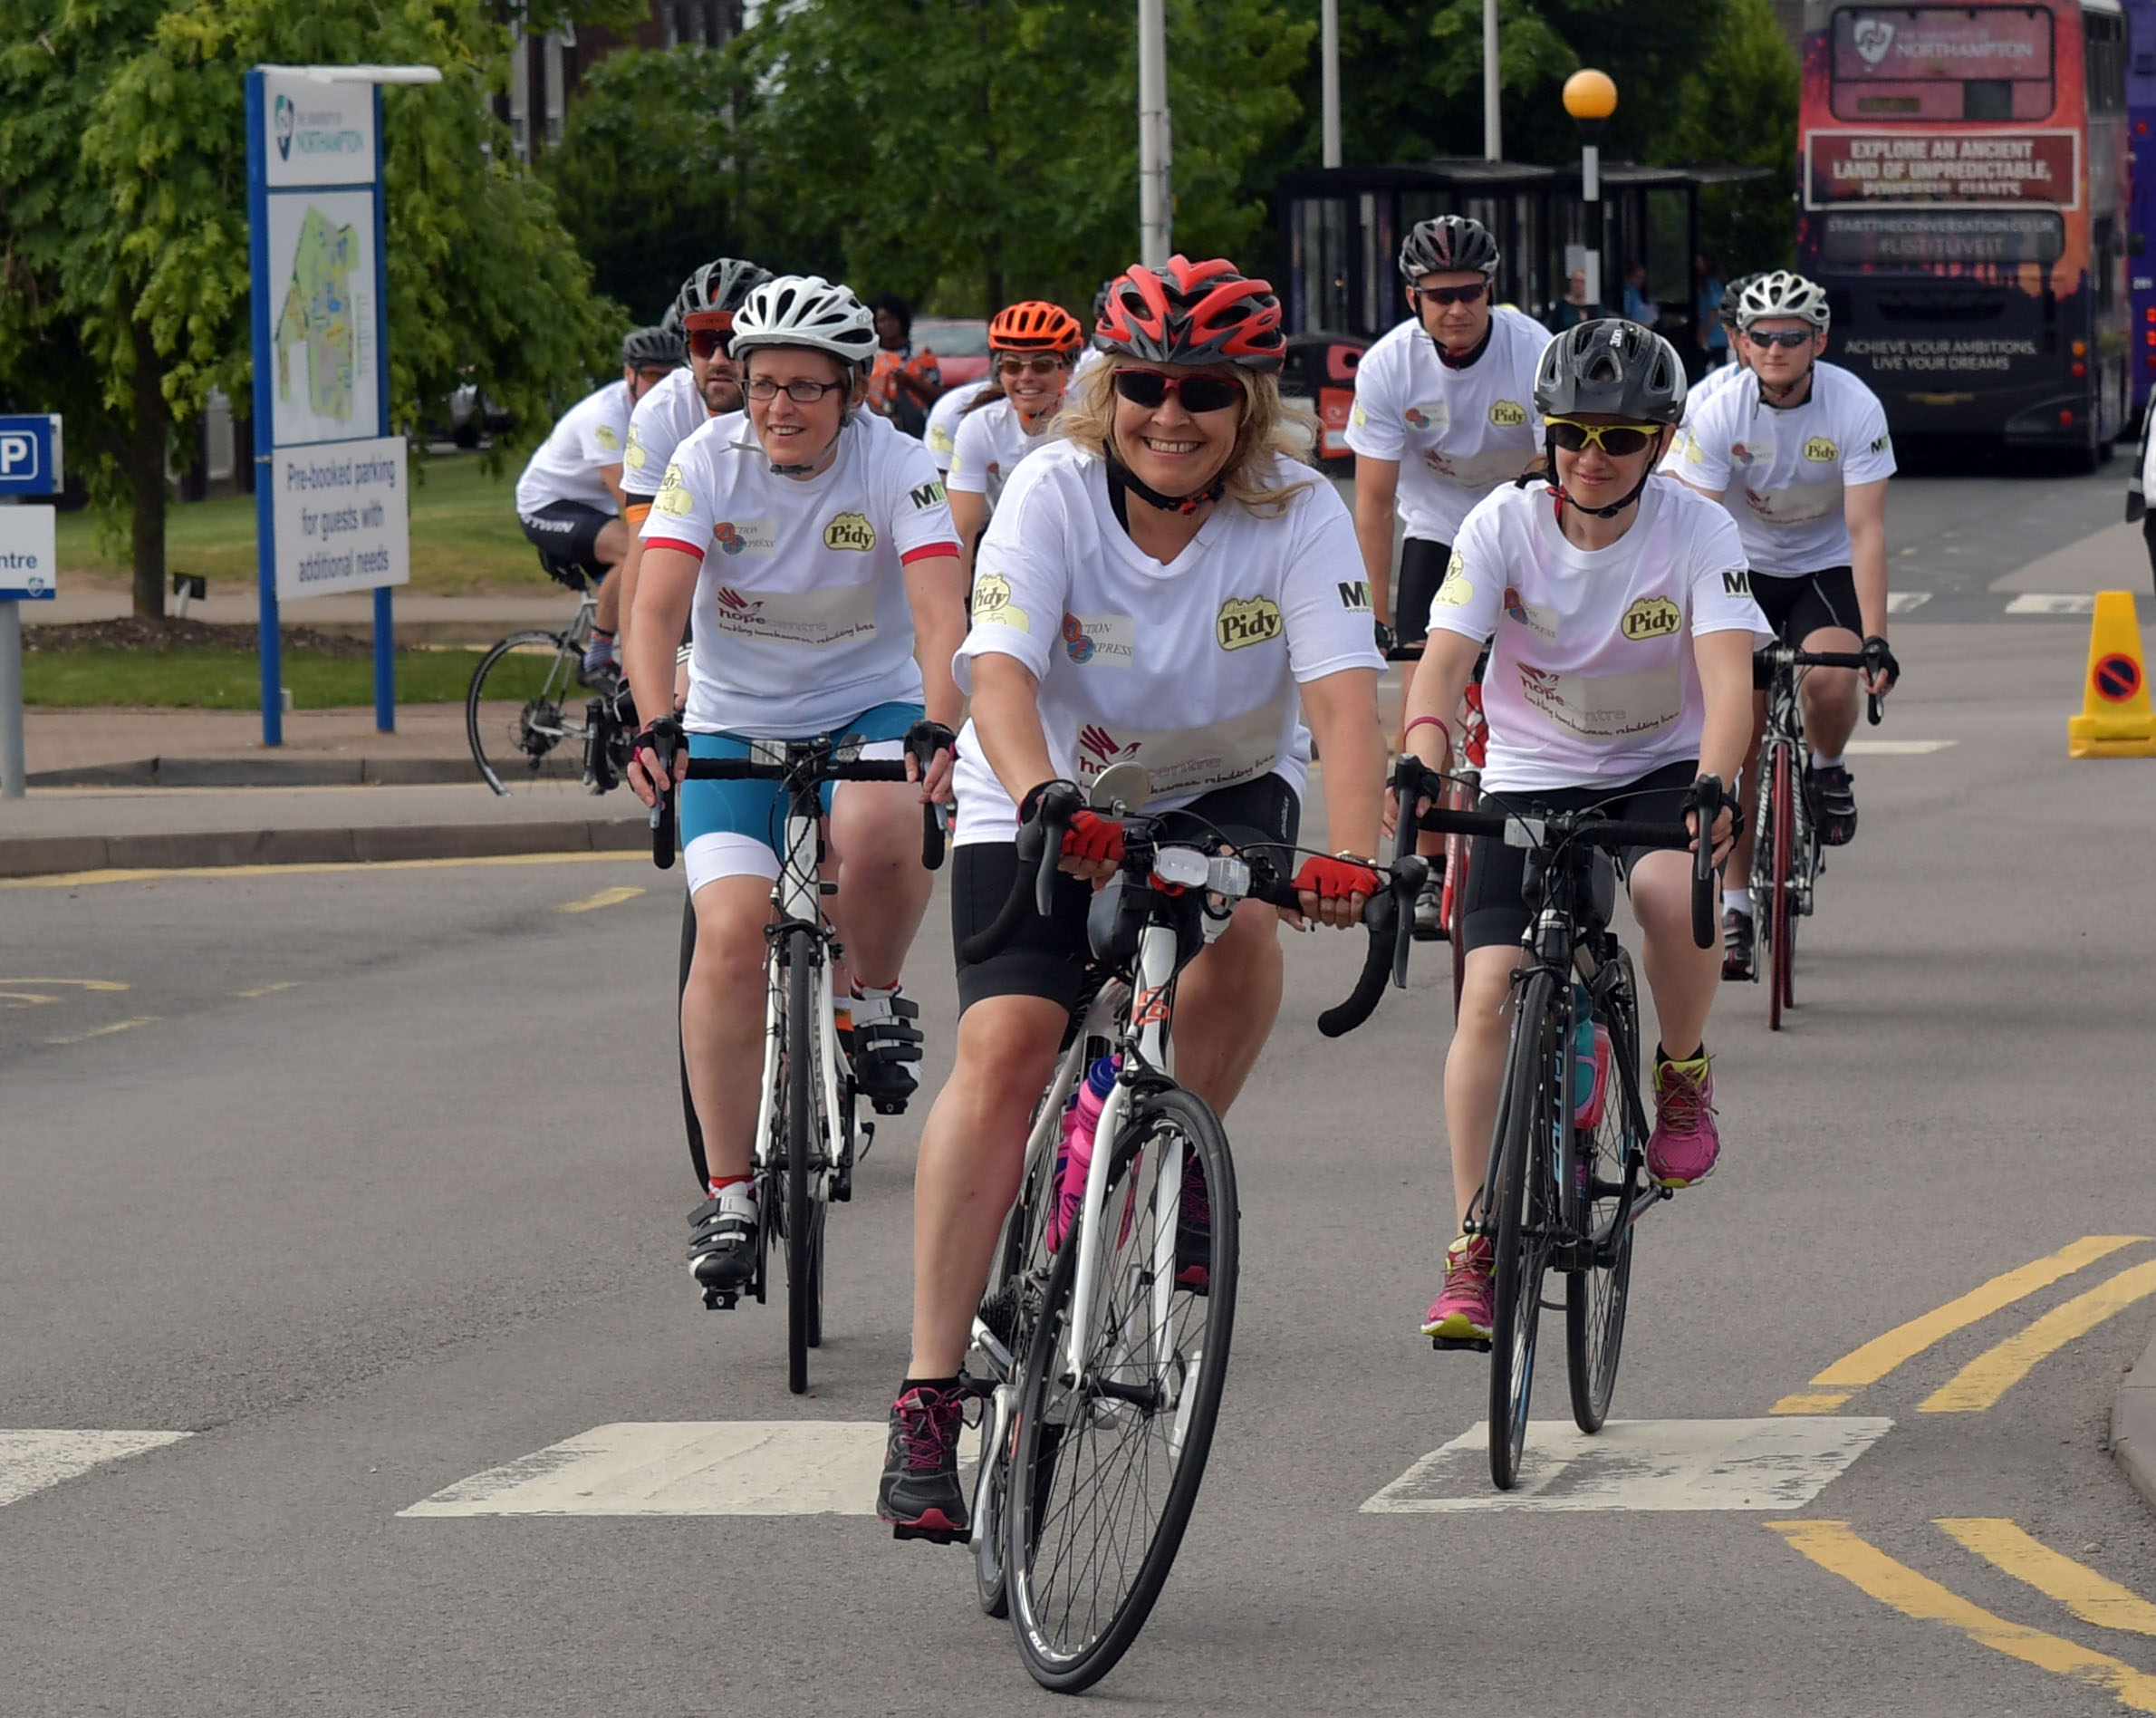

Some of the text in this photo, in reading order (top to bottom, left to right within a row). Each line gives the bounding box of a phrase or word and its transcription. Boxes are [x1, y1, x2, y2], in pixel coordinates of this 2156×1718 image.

[1896, 42, 2033, 57] NORTHAMPTON
[1851, 140, 2034, 159] EXPLORE AN ANCIENT
[1833, 160, 1879, 179] LAND
[1882, 160, 1905, 179] OF
[1844, 341, 1906, 354] ACHIEVE
[1911, 341, 1949, 354] YOUR
[1872, 356, 2010, 371] LIVE YOUR DREAMS
[1495, 409, 1525, 425] Pidy
[1, 438, 28, 474] P
[1808, 444, 1835, 460] Pidy
[287, 454, 395, 491] Pre-booked parking
[301, 499, 384, 542] for guests with
[829, 525, 873, 549] Pidy
[299, 544, 390, 584] additional needs
[718, 607, 765, 624] hope
[1628, 608, 1679, 634] Pidy
[1220, 608, 1280, 645] Pidy
[1521, 676, 1565, 706] hope
